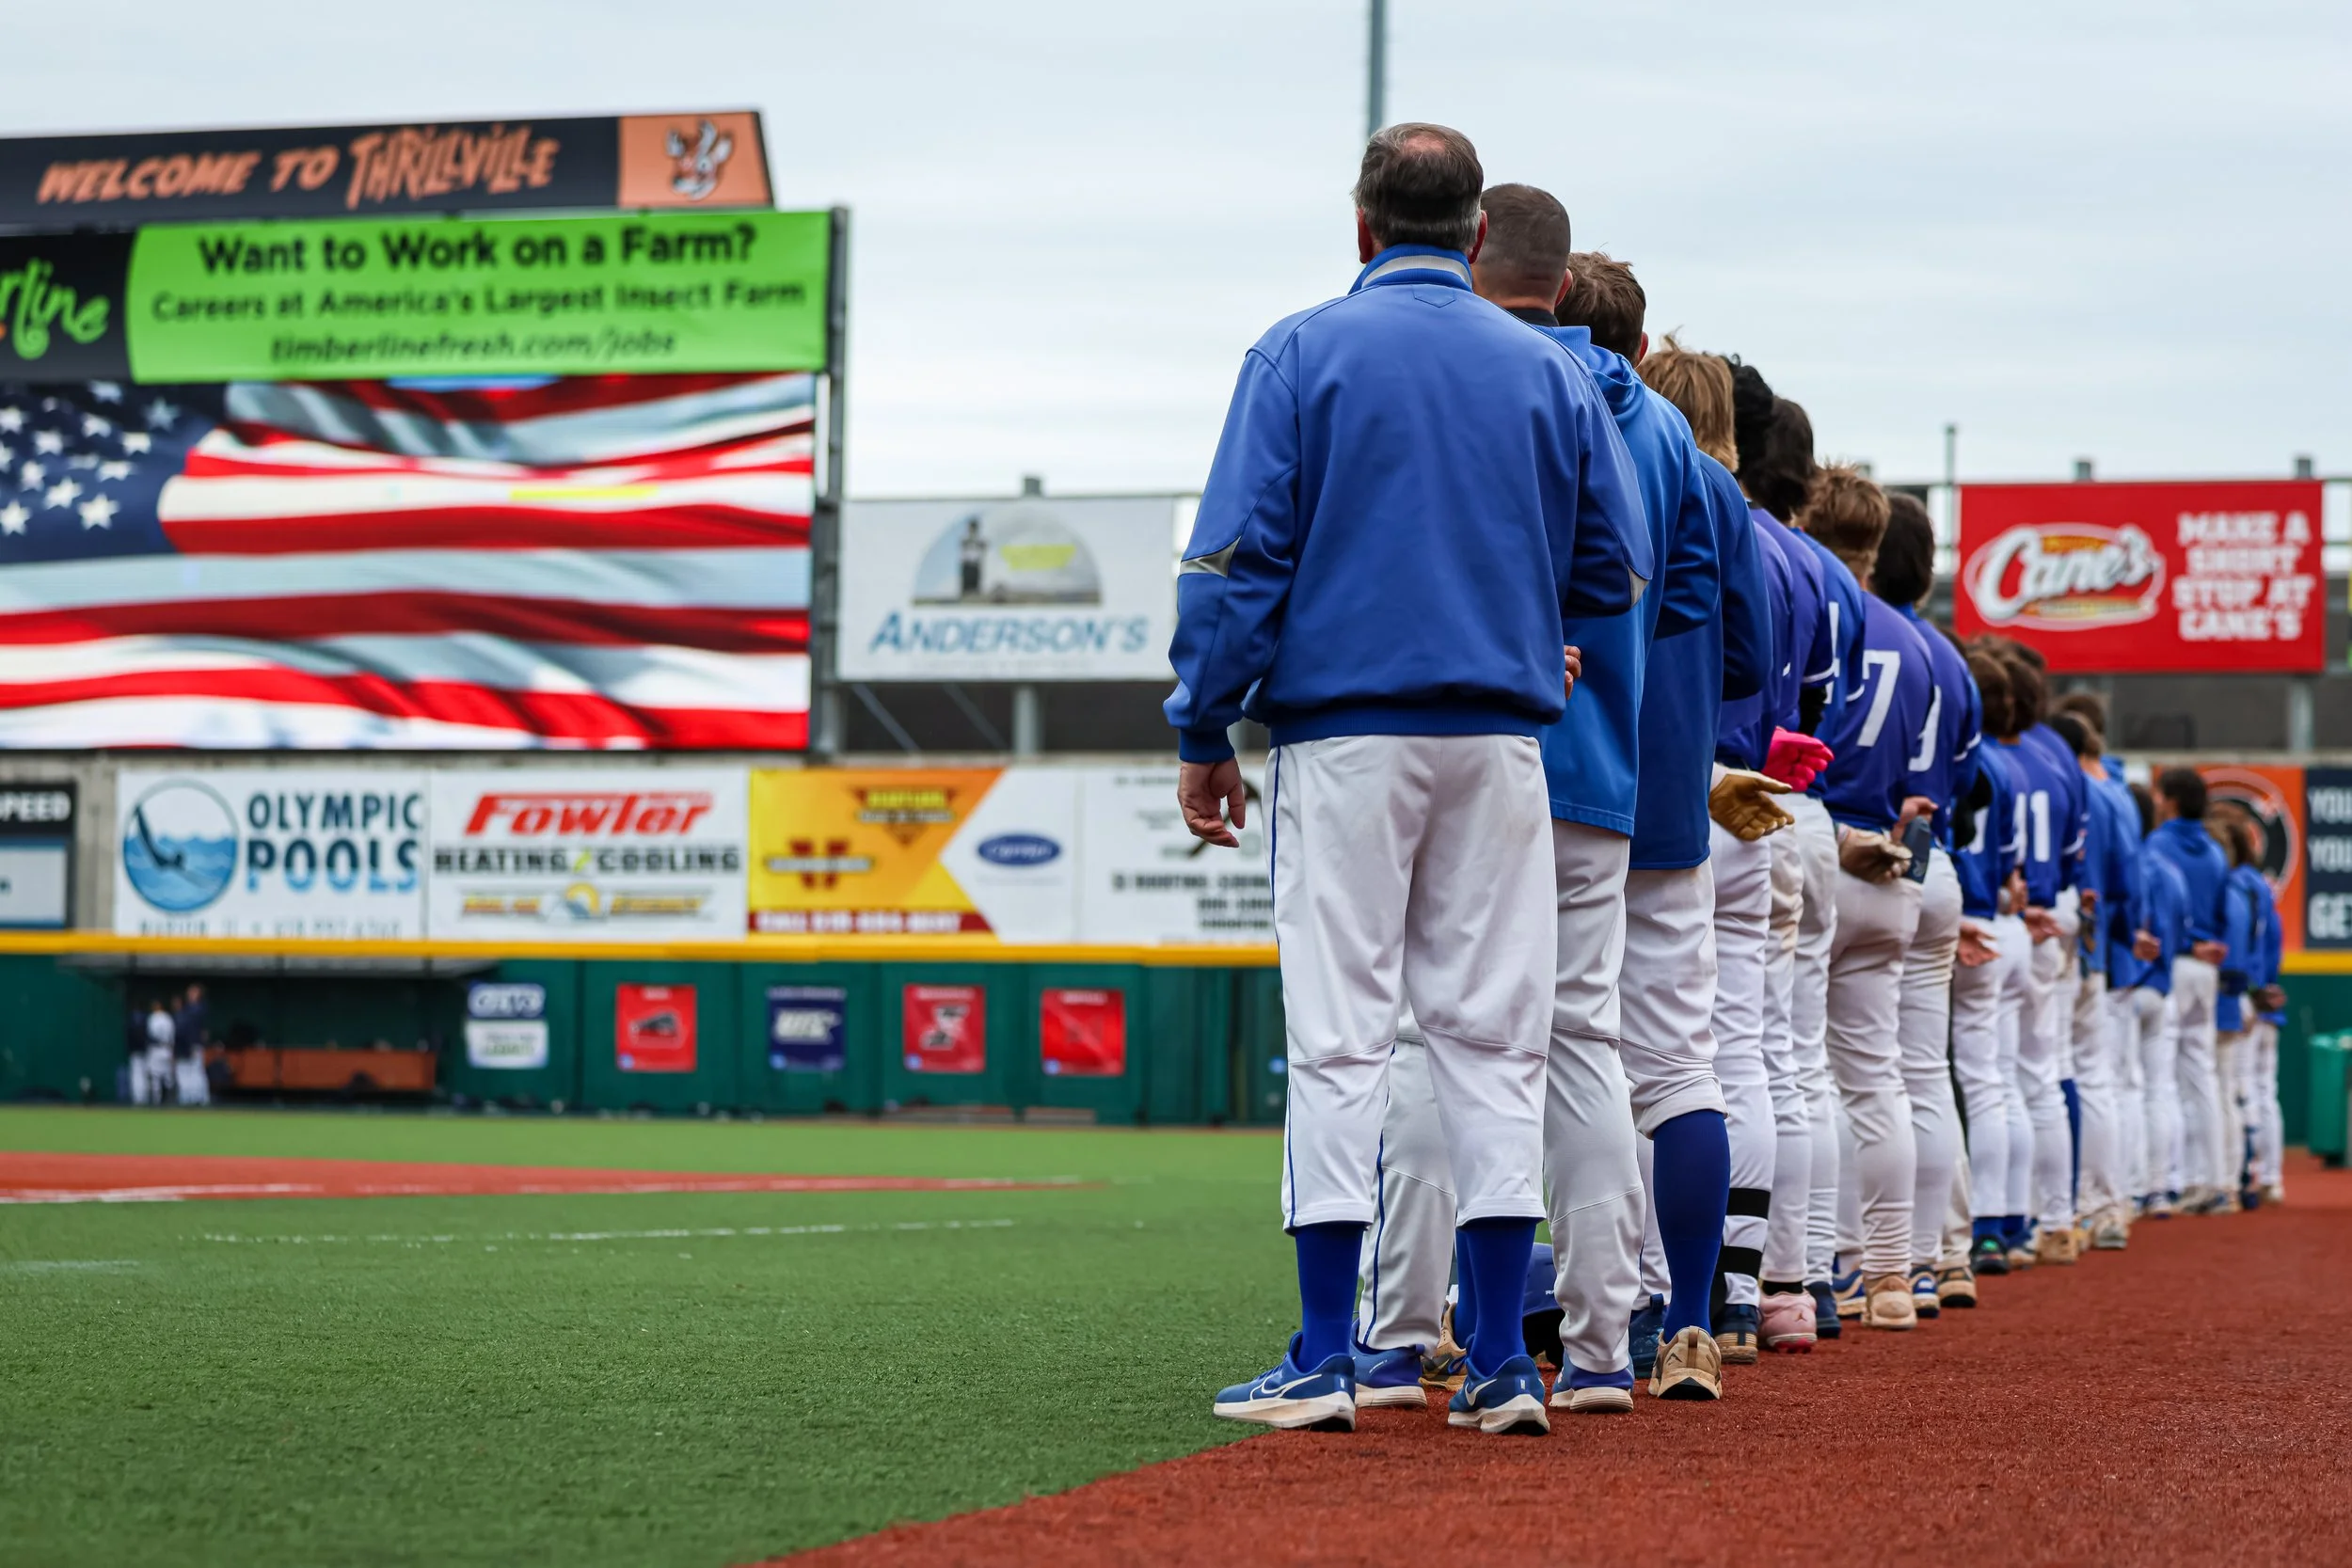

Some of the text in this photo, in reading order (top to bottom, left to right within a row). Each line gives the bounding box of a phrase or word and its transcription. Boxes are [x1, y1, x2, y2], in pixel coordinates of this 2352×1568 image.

[38, 151, 261, 203] WELCOME
[271, 145, 340, 191] TO
[199, 224, 756, 276] Want to Work on a Farm?
[151, 279, 806, 323] Careers at America's Largest Insect Farm
[270, 325, 677, 364] timberlinefresh.com/jobs
[2177, 511, 2311, 546] MAKE A
[1976, 525, 2162, 619] Cane's
[2172, 575, 2263, 610] STOP
[2268, 575, 2315, 610] AT
[868, 610, 1149, 652] ANDERSON'S
[2178, 610, 2302, 641] CANE'S
[1857, 649, 1900, 747] 7
[247, 793, 423, 830] OLYMPIC
[463, 792, 714, 835] Fowler
[246, 838, 421, 893] POOLS
[434, 847, 569, 873] HEATING
[596, 847, 740, 873] COOLING
